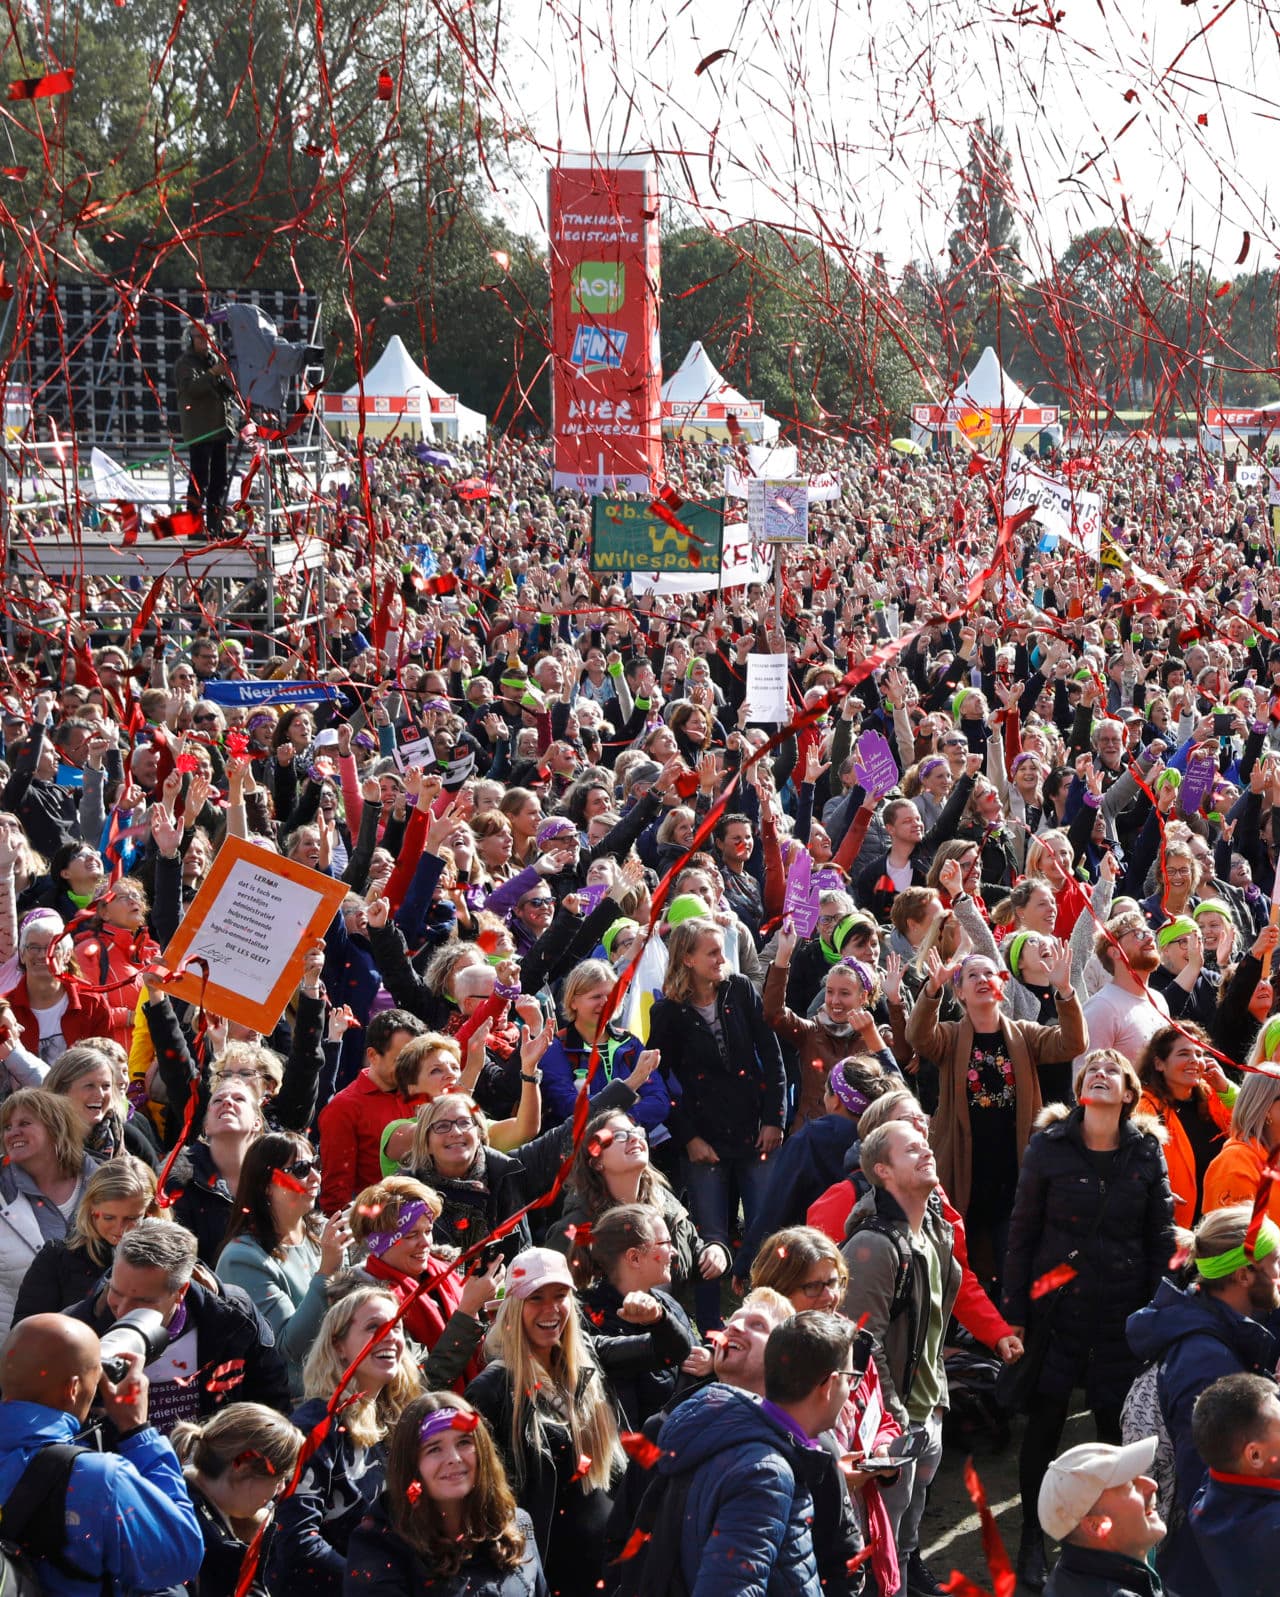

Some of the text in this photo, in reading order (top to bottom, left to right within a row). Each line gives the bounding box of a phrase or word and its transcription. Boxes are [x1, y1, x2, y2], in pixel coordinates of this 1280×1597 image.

[574, 333, 626, 363] FNV
[568, 399, 632, 420] HIER
[1214, 413, 1255, 424] MEET
[561, 422, 640, 435] INLEVEREN
[237, 880, 283, 902] dat is toch een
[254, 873, 279, 889] LERAAR
[232, 900, 275, 921] administratief
[223, 917, 267, 940] allrounder met
[225, 942, 271, 966] DIE LES GEEFT
